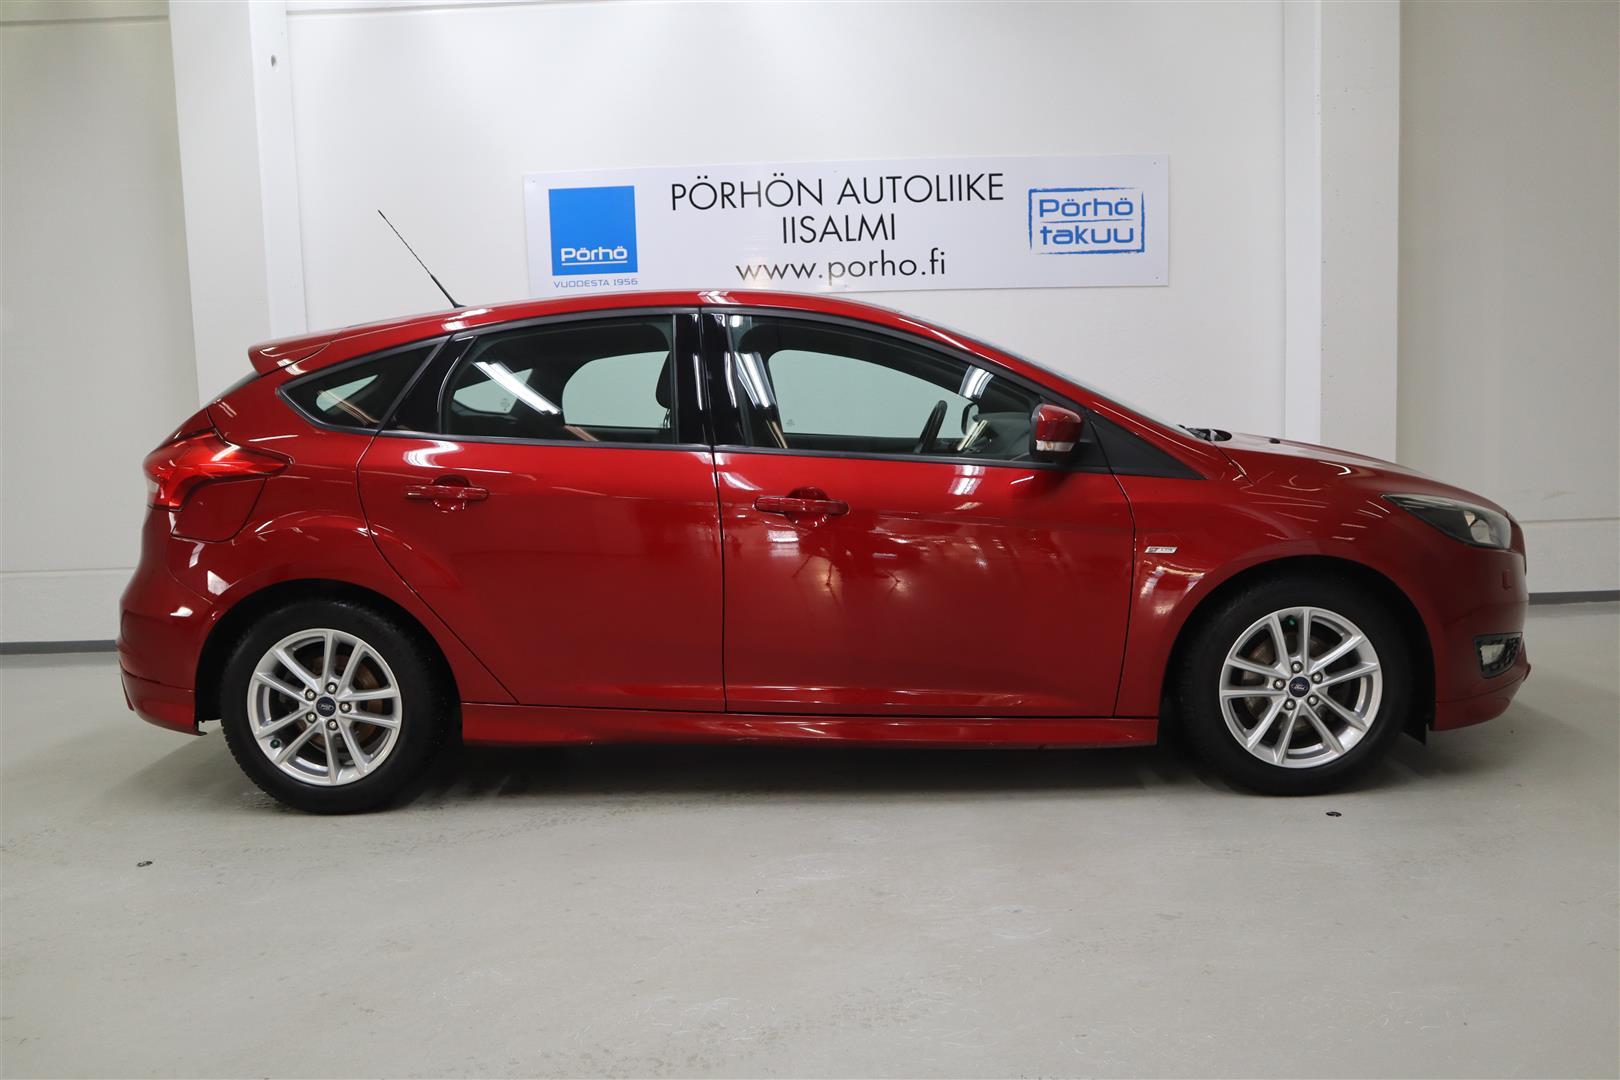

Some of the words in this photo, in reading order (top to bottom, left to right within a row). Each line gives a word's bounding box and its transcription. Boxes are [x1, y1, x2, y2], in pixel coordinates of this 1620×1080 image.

[671, 172, 823, 211] PÖRHÖN
[836, 172, 1004, 206] AUTOLIIKE
[1039, 197, 1134, 218] Pörhö
[782, 212, 896, 244] IISALMI
[1039, 225, 1135, 246] takuu
[560, 245, 628, 262] Pörhö
[735, 247, 946, 286] www.porho.fi
[554, 279, 610, 288] VUODESTA
[613, 277, 638, 286] 1956
